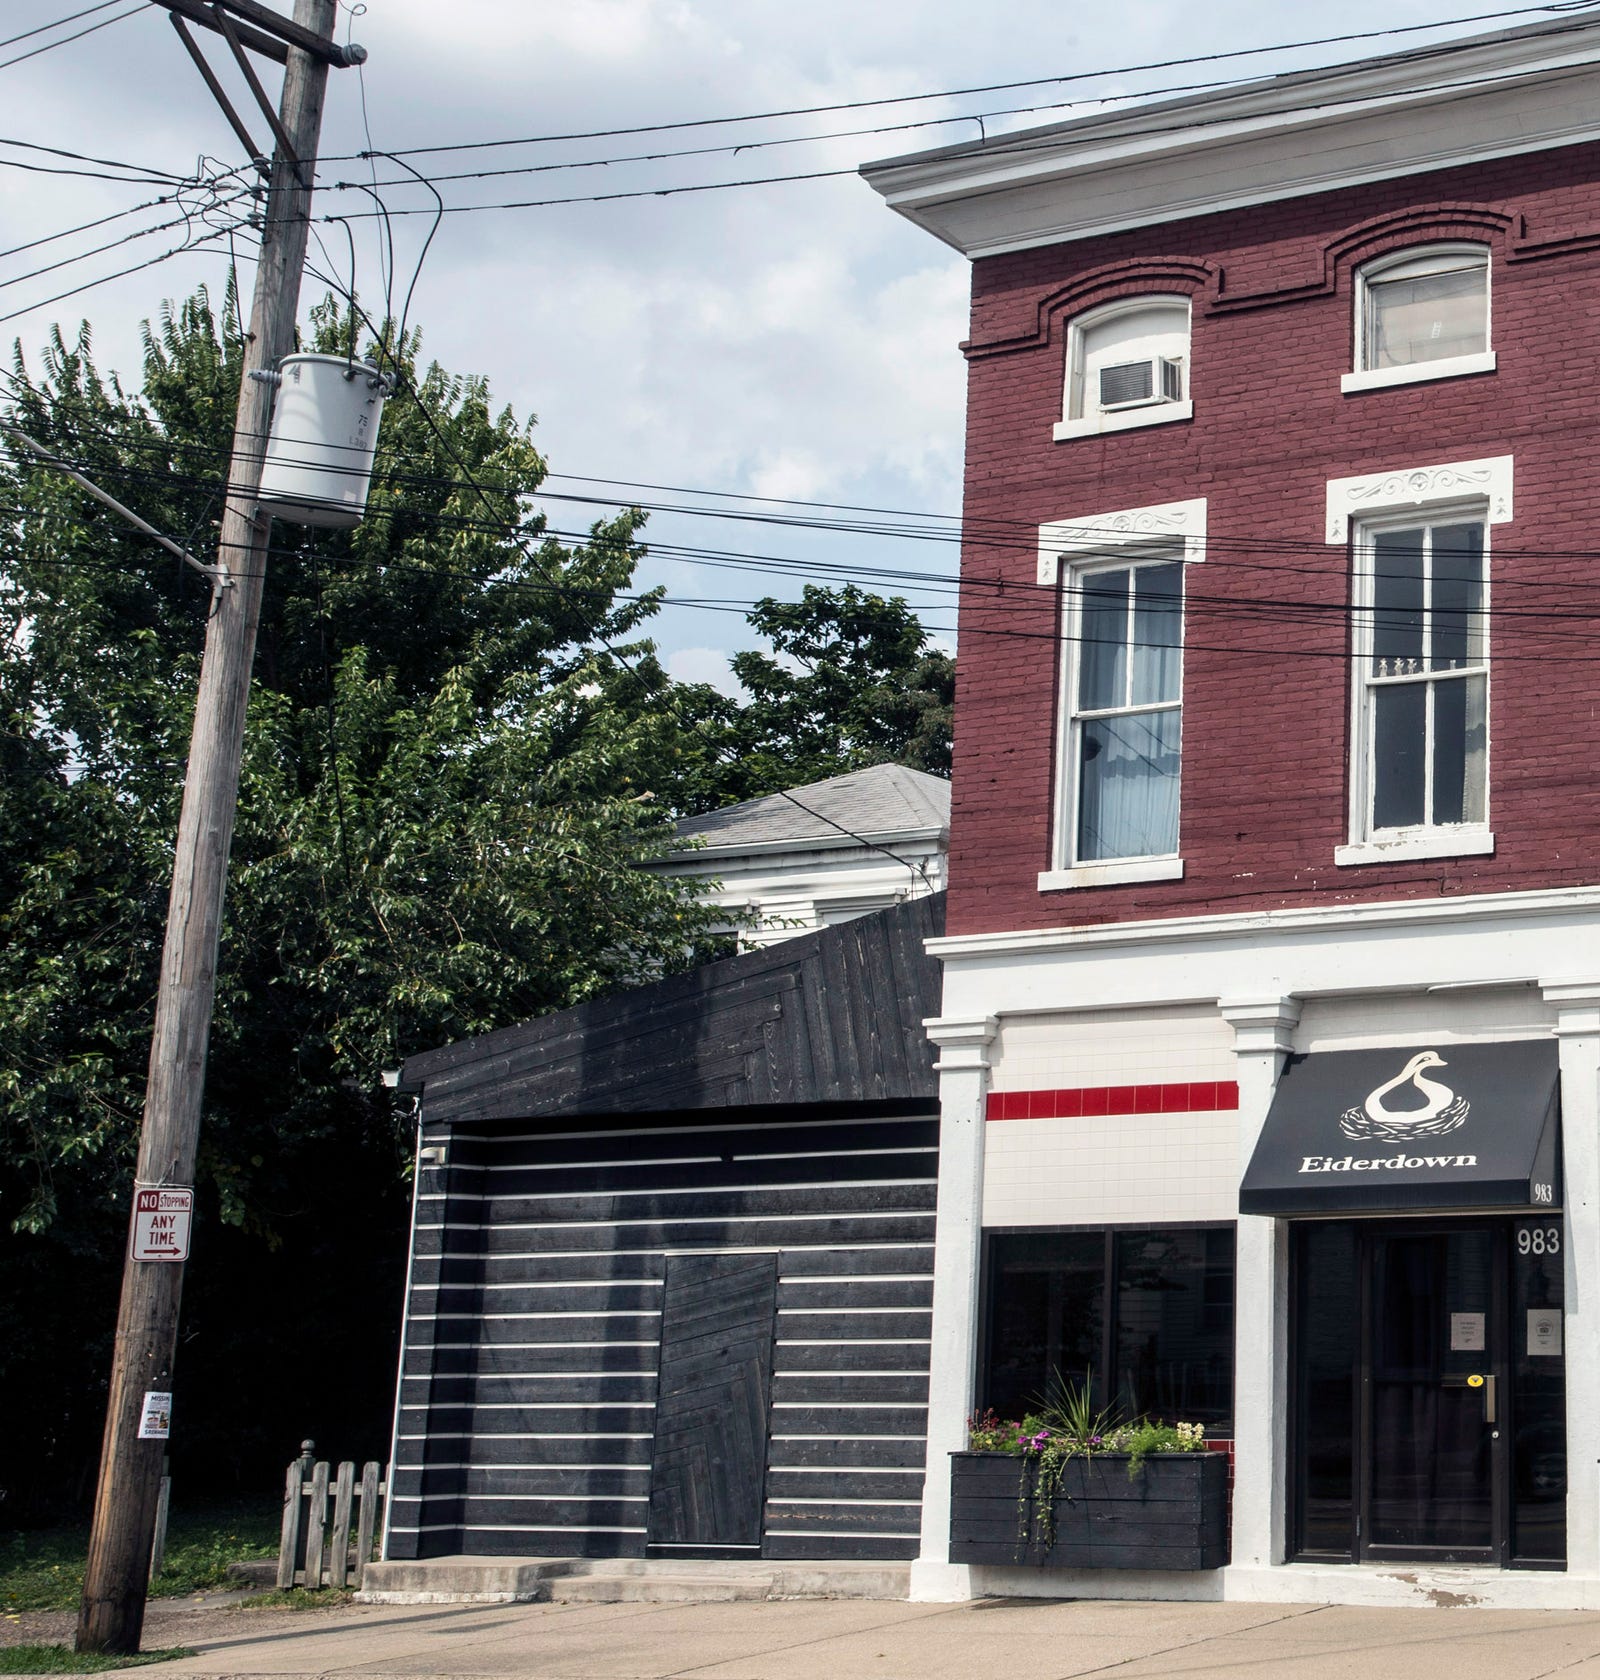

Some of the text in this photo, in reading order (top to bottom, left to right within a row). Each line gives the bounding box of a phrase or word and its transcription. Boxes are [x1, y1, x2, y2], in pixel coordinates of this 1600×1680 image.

[1298, 1153, 1478, 1173] Eiderdown
[1535, 1184, 1553, 1203] 983
[140, 1195, 189, 1209] NO STOPPING
[151, 1215, 176, 1229] ANY
[149, 1231, 176, 1245] TIME
[1517, 1228, 1560, 1255] 983
